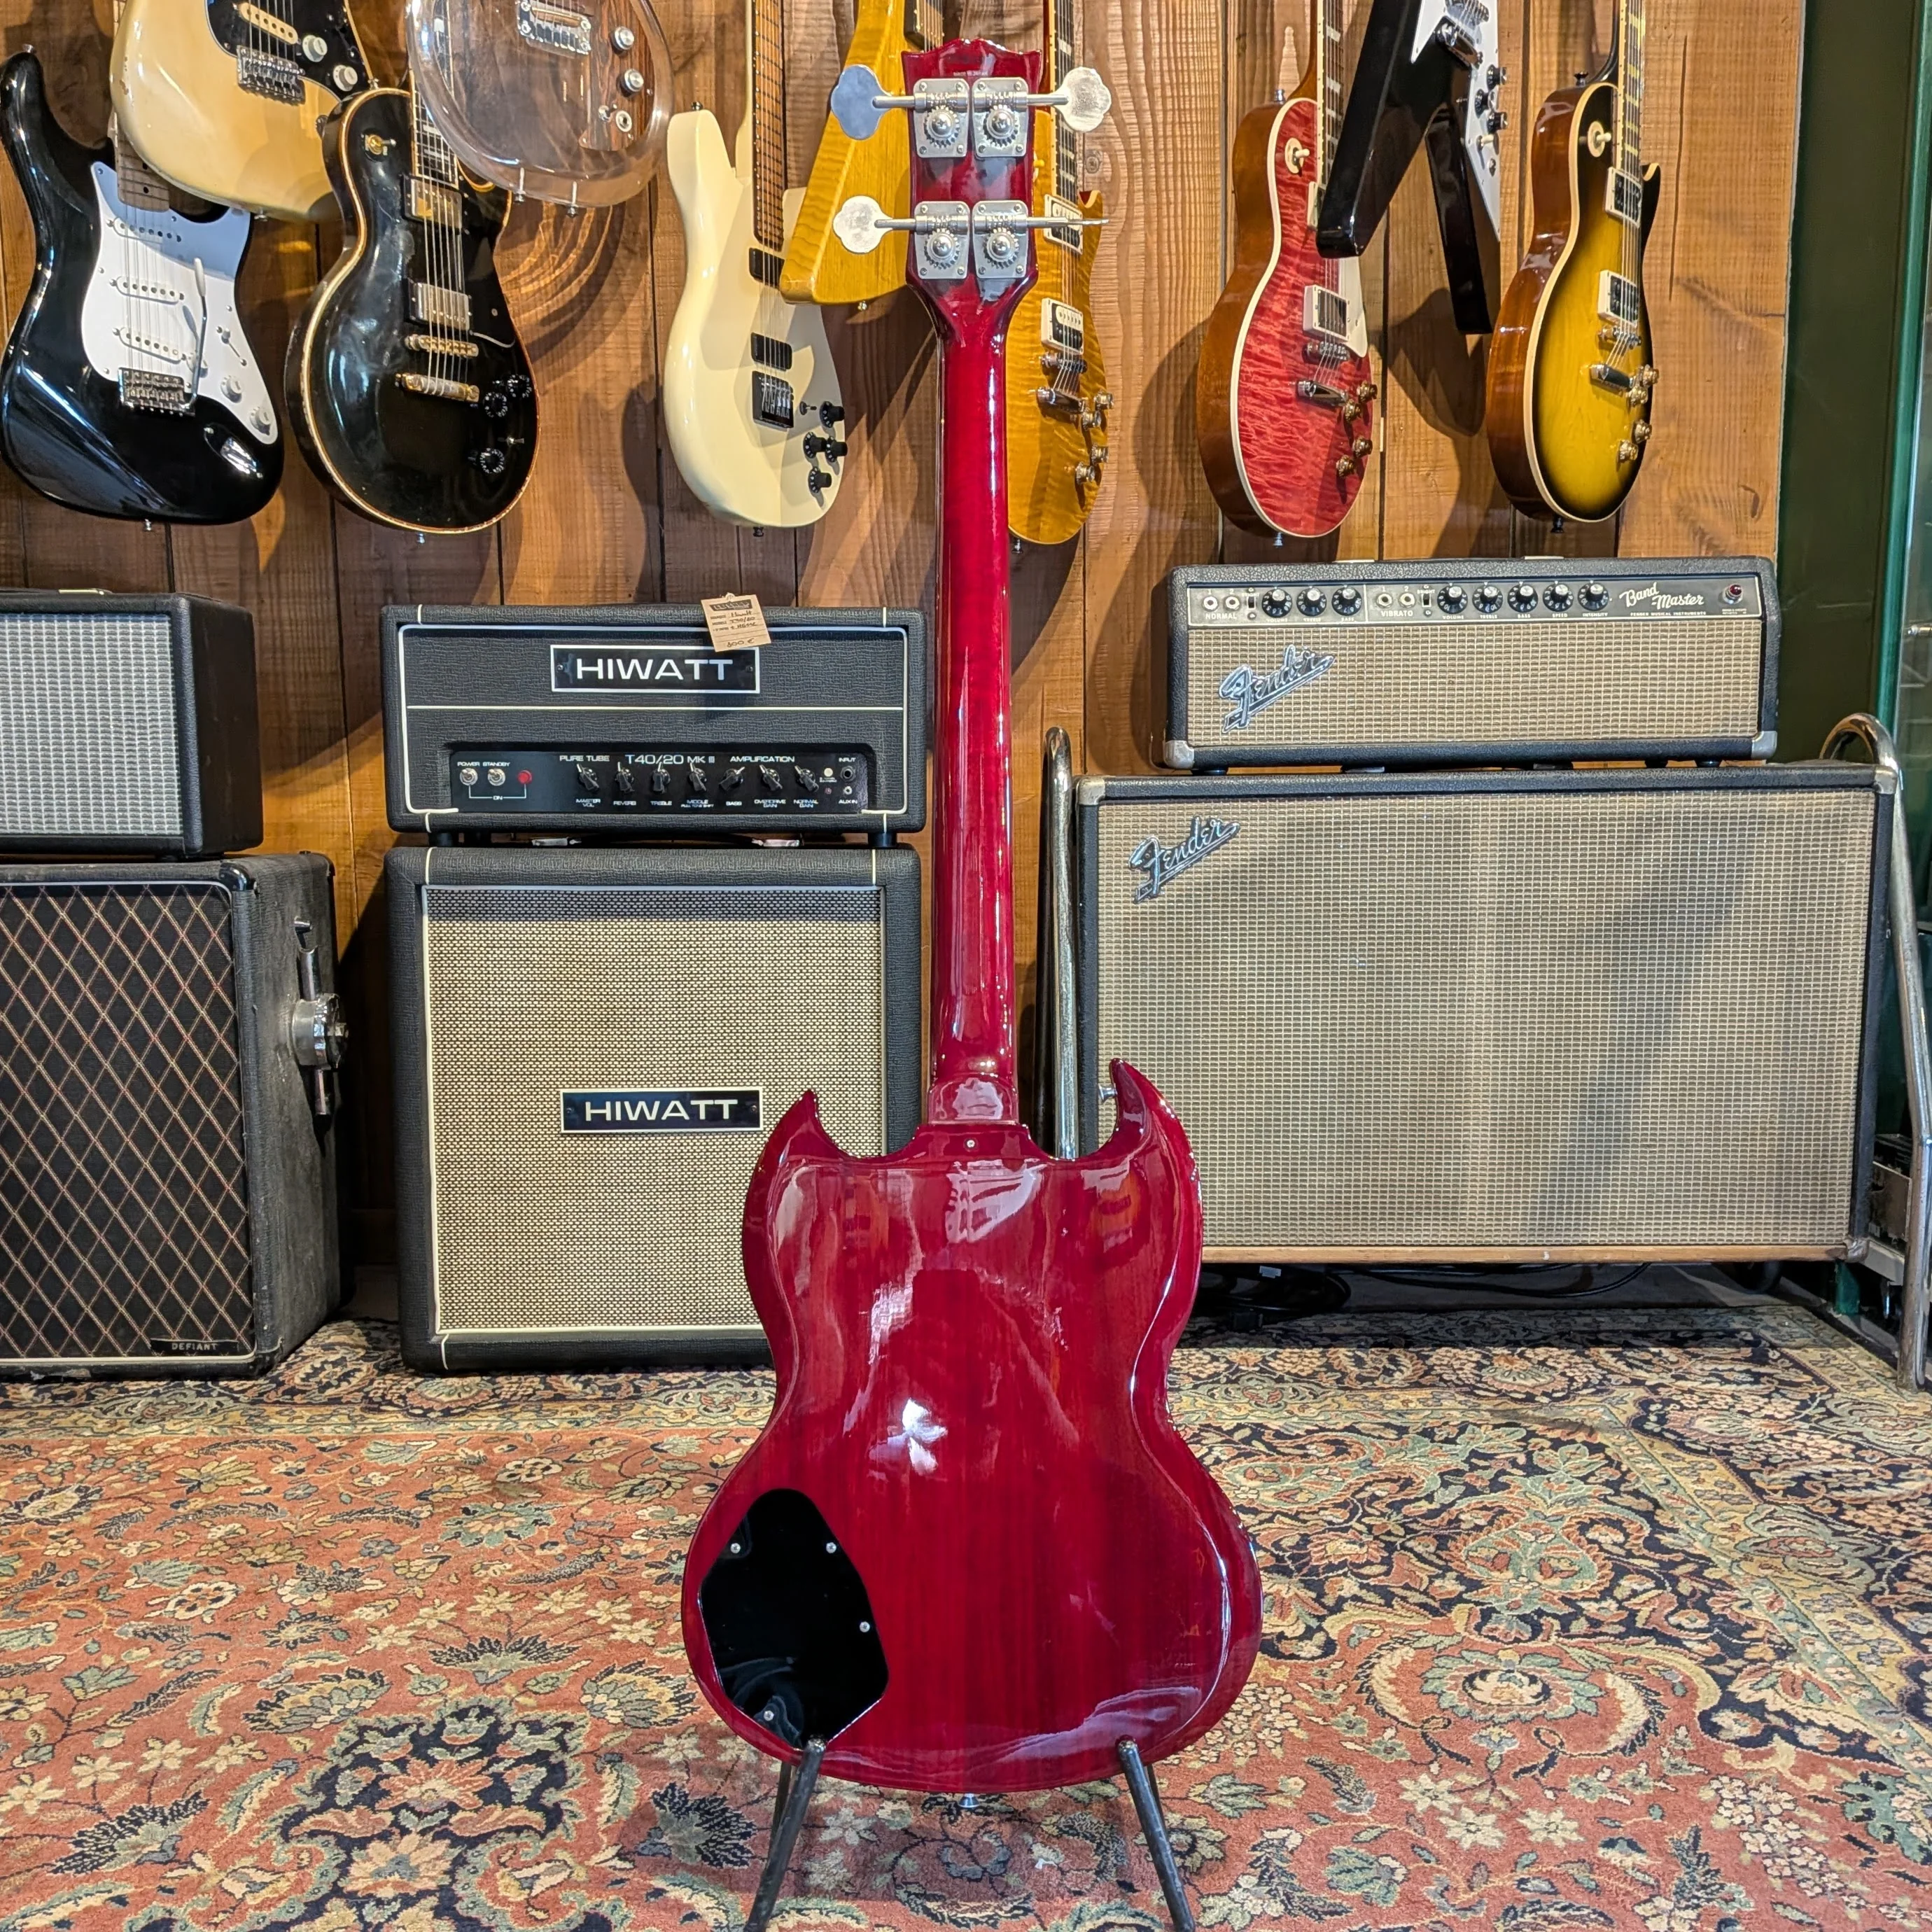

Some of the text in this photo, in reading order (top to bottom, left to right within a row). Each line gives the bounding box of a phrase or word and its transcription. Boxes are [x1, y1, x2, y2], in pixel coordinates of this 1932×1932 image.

[1618, 582, 1660, 608] Band
[576, 658, 733, 680] HIWATT
[1219, 644, 1335, 734] Fender
[624, 754, 685, 764] T40/20
[687, 755, 706, 764] MK
[1128, 815, 1241, 904] Fender
[585, 1099, 738, 1121] HIWATT
